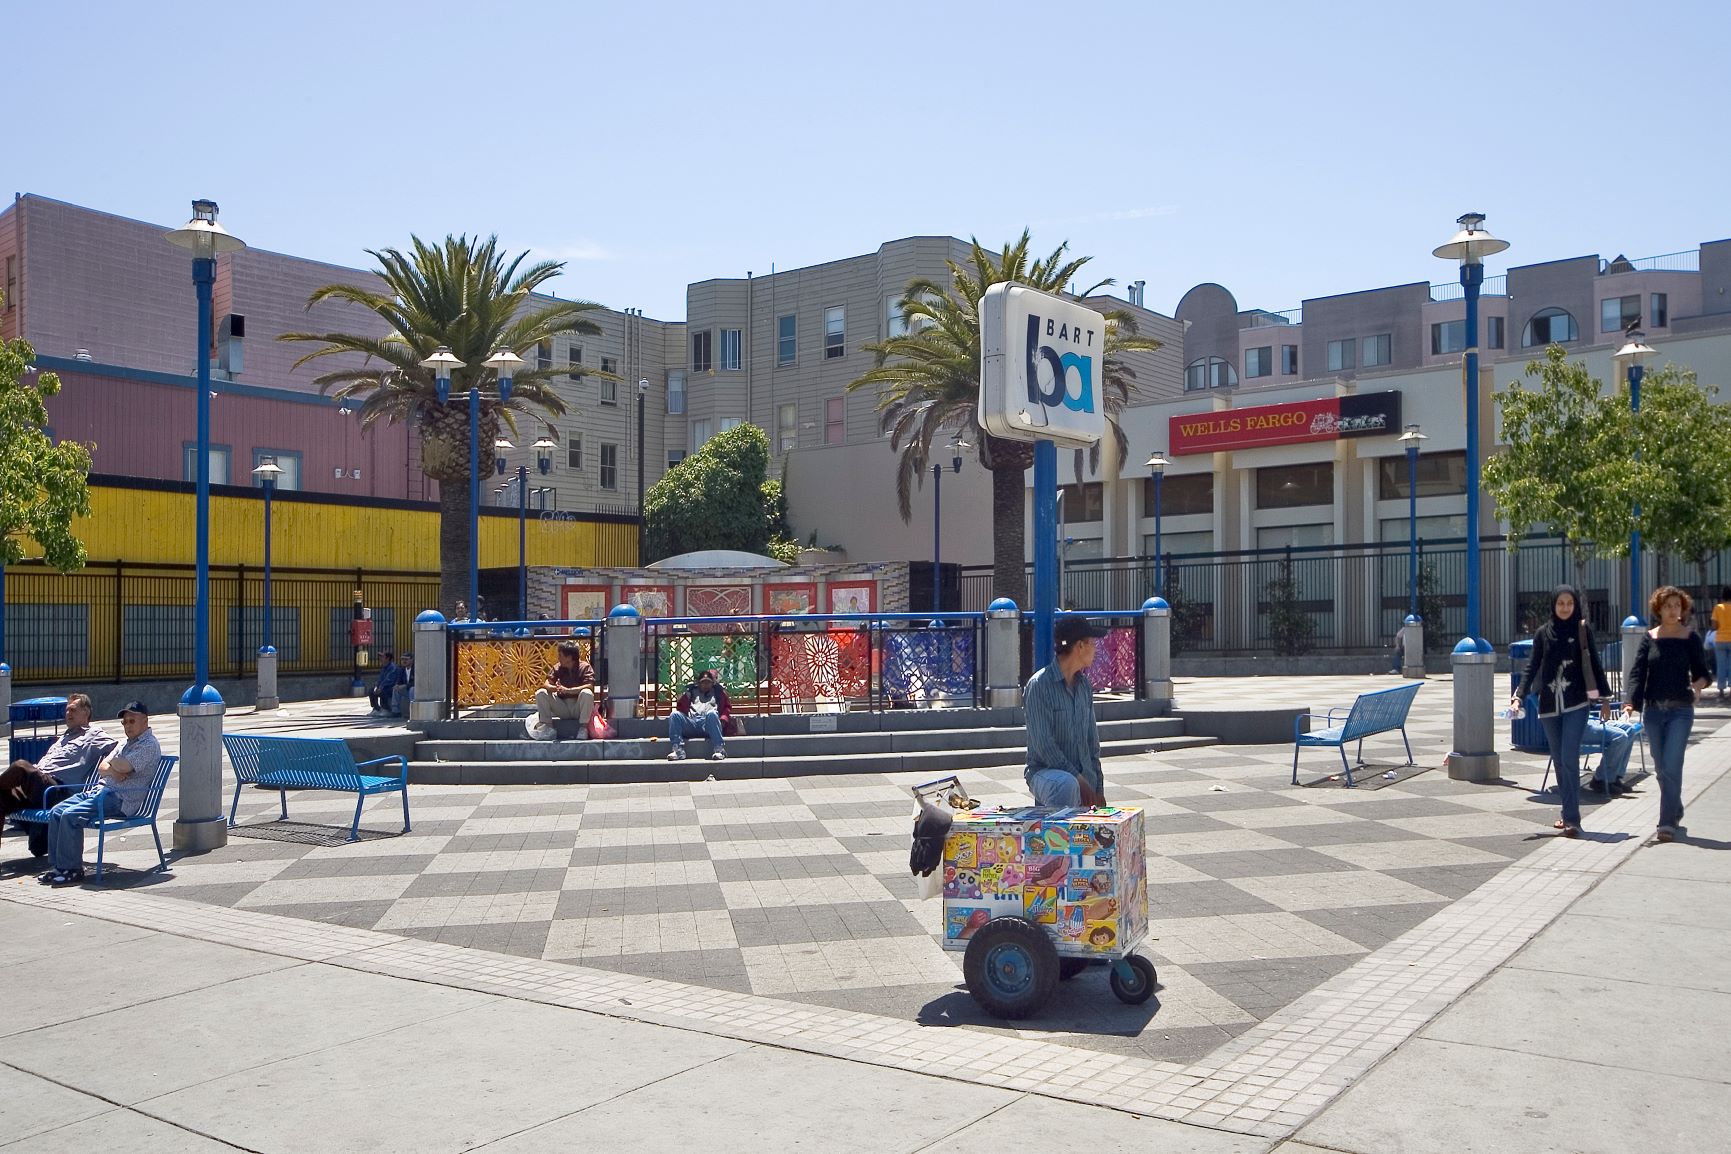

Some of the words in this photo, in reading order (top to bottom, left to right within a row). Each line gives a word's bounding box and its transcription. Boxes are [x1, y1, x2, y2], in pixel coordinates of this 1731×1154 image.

[1046, 318, 1094, 347] BART
[1180, 418, 1241, 438] WELLS
[1246, 411, 1307, 431] FARGO
